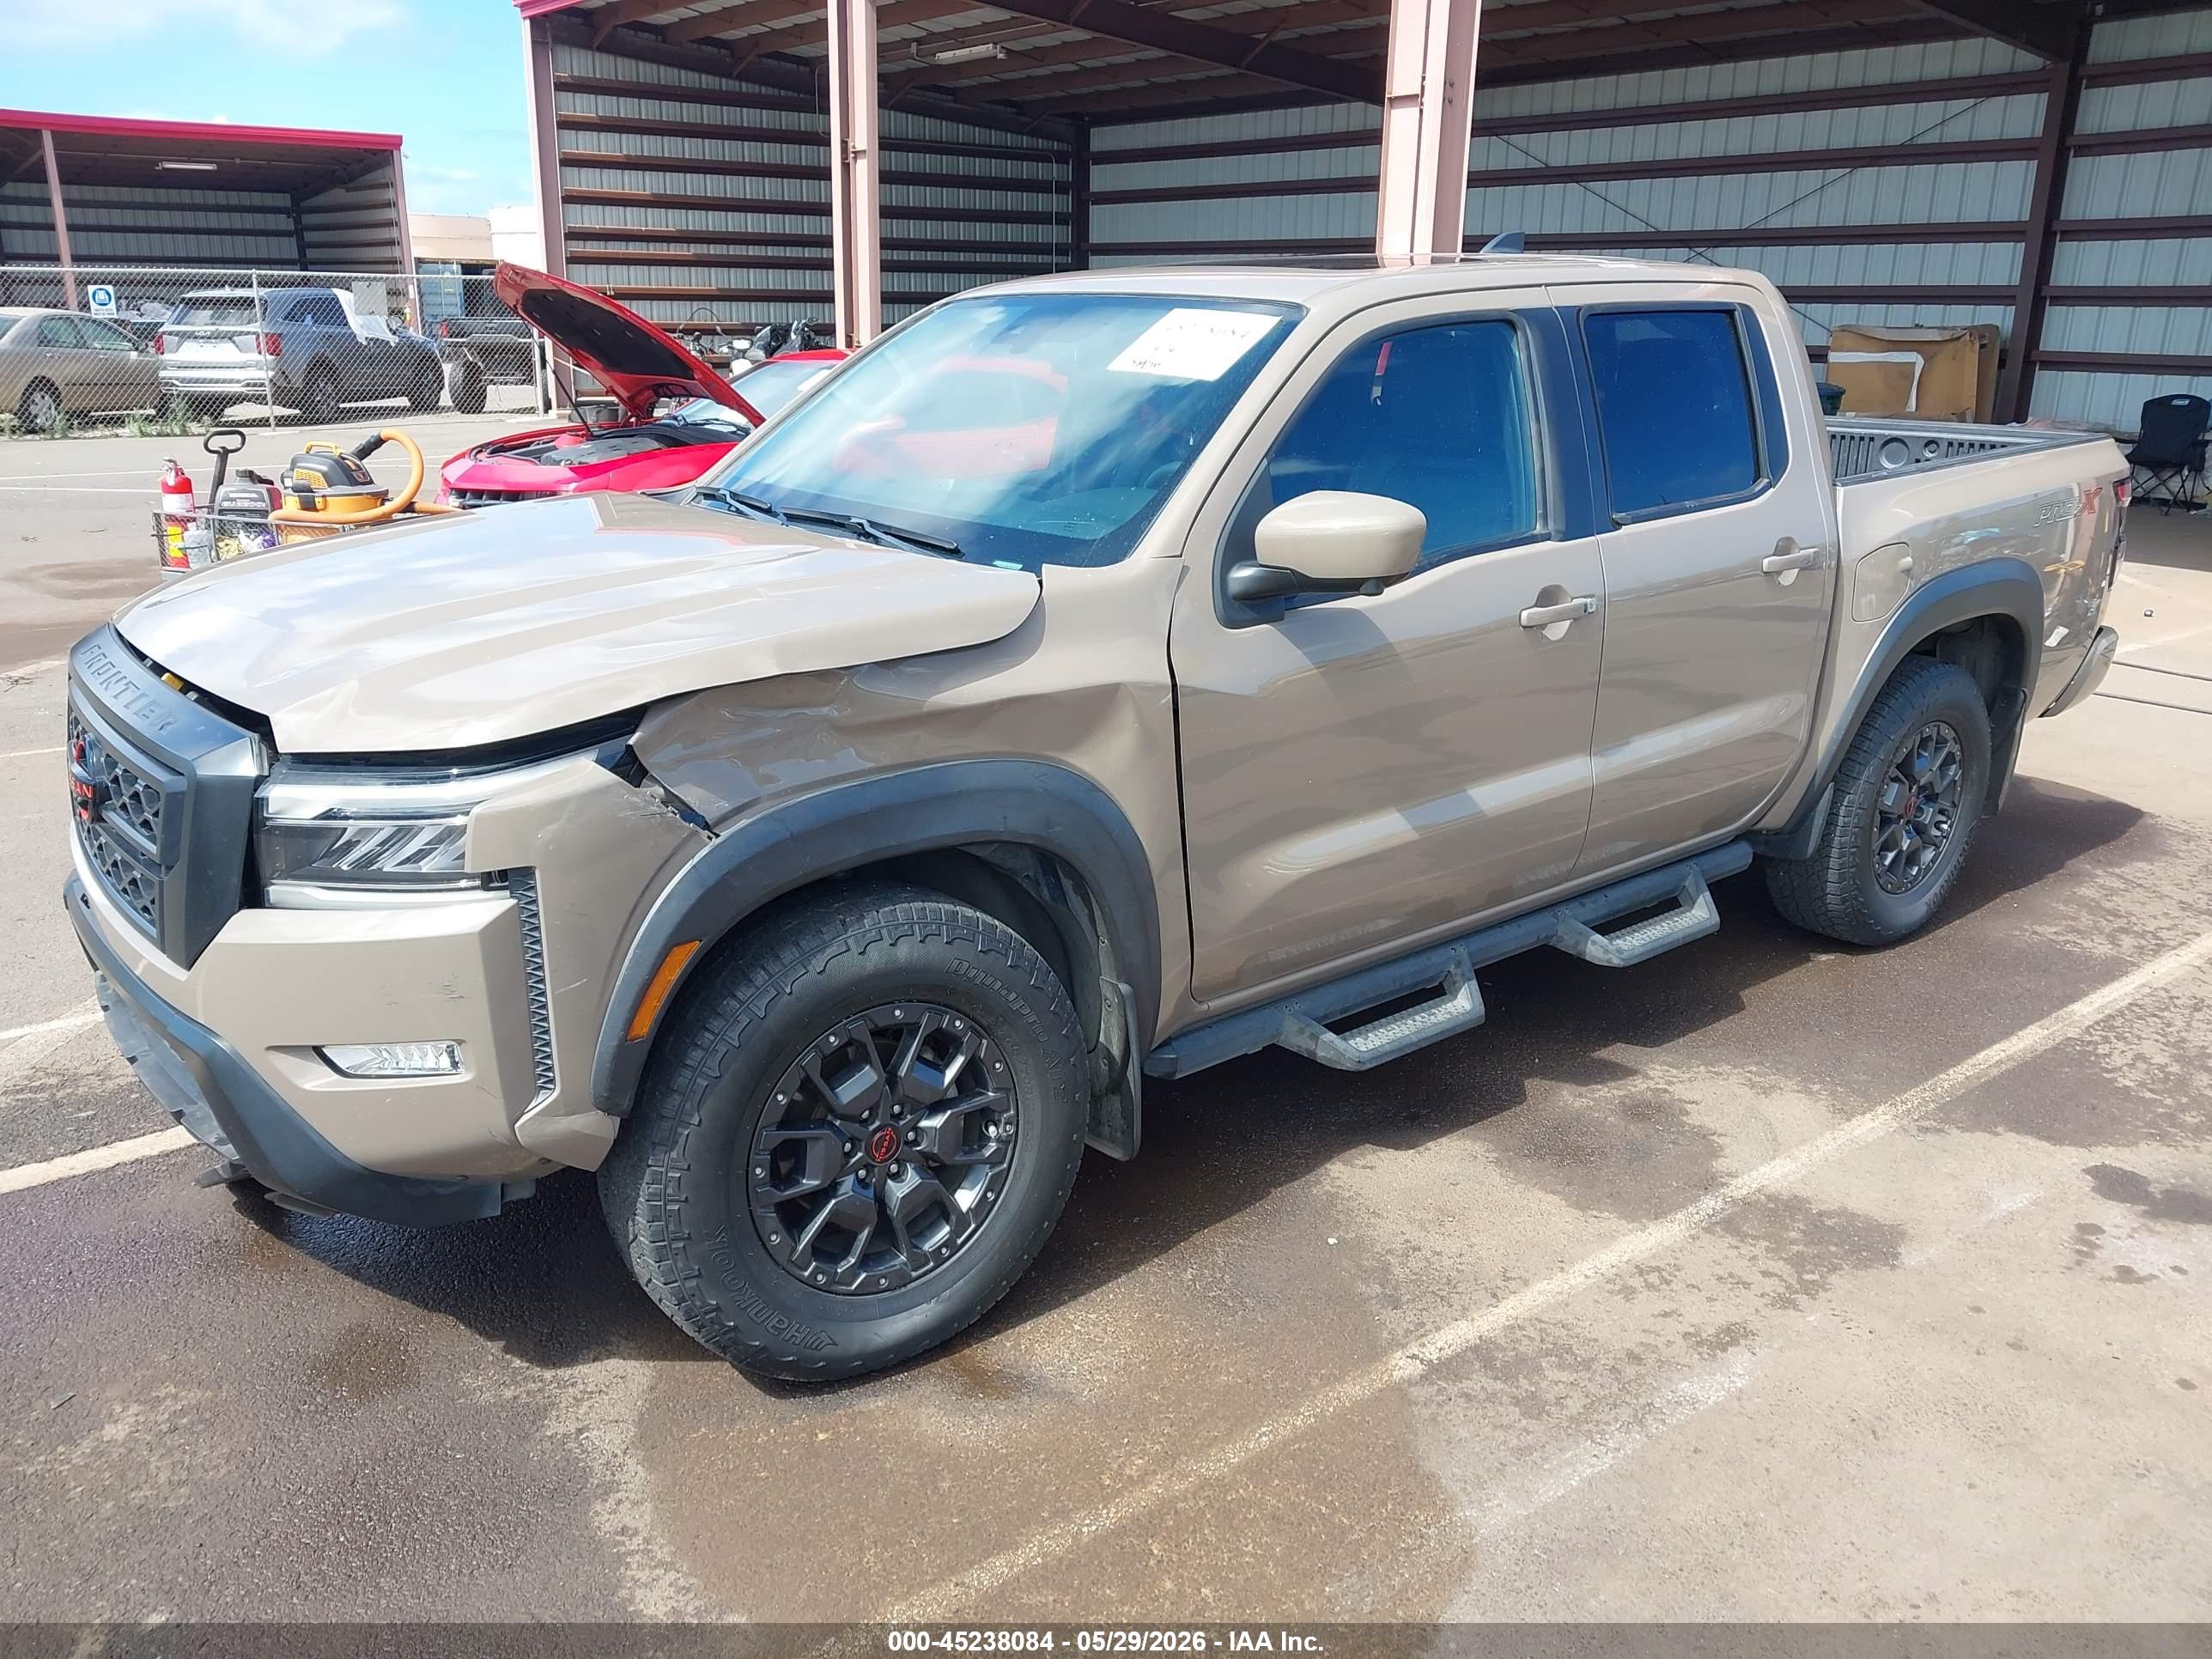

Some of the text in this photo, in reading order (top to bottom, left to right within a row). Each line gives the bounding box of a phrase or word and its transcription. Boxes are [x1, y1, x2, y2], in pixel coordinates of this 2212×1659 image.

[80, 643, 182, 734] FRONTIER
[945, 957, 1048, 1042] Dynapro
[875, 1126, 893, 1162] NISSAN
